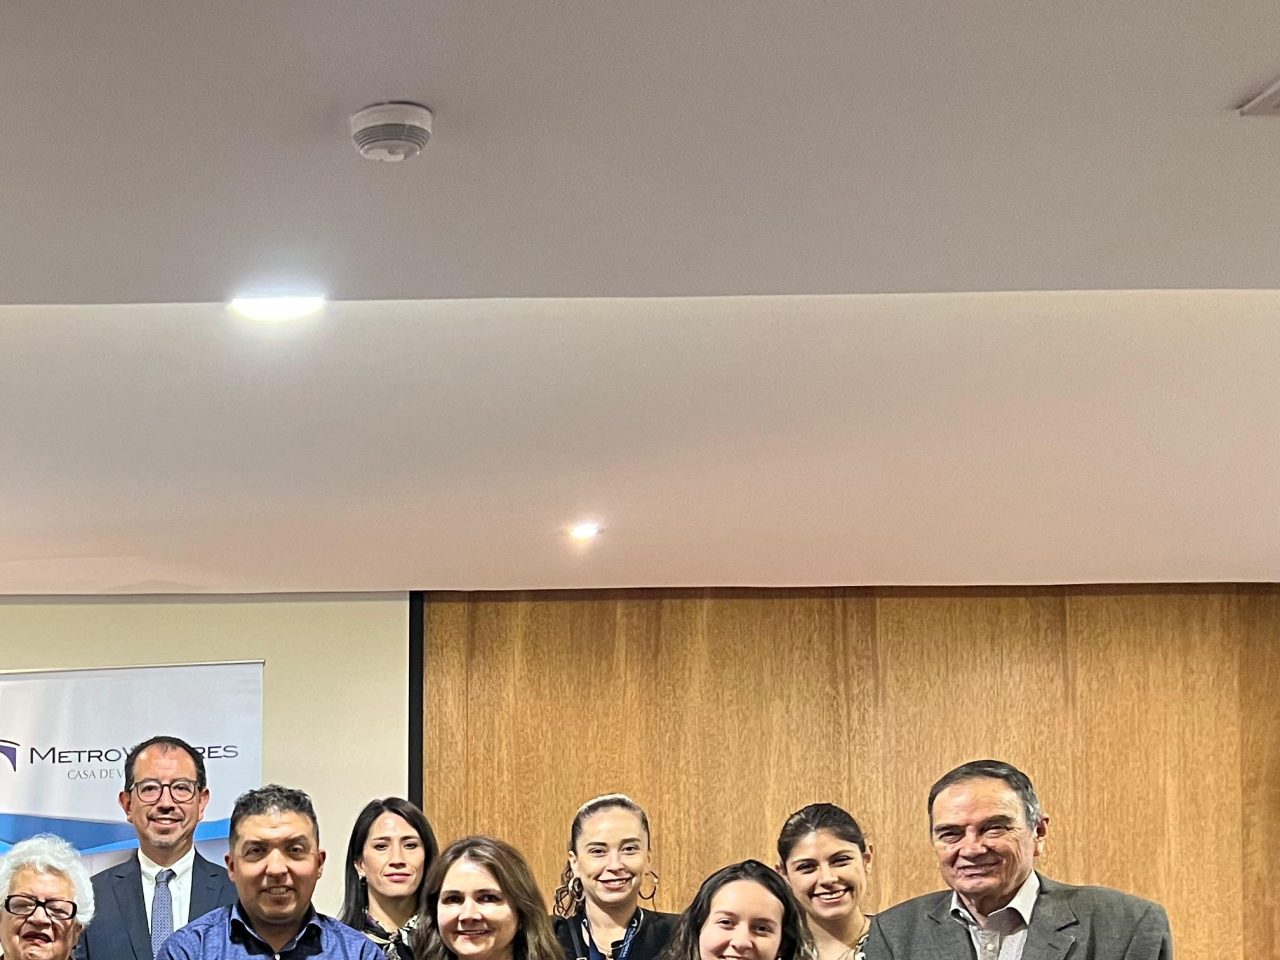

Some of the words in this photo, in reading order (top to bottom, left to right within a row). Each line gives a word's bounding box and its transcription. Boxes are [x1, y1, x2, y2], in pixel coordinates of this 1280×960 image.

[30, 745, 239, 764] METRORES
[67, 769, 96, 780] CASA
[99, 768, 115, 779] DE
